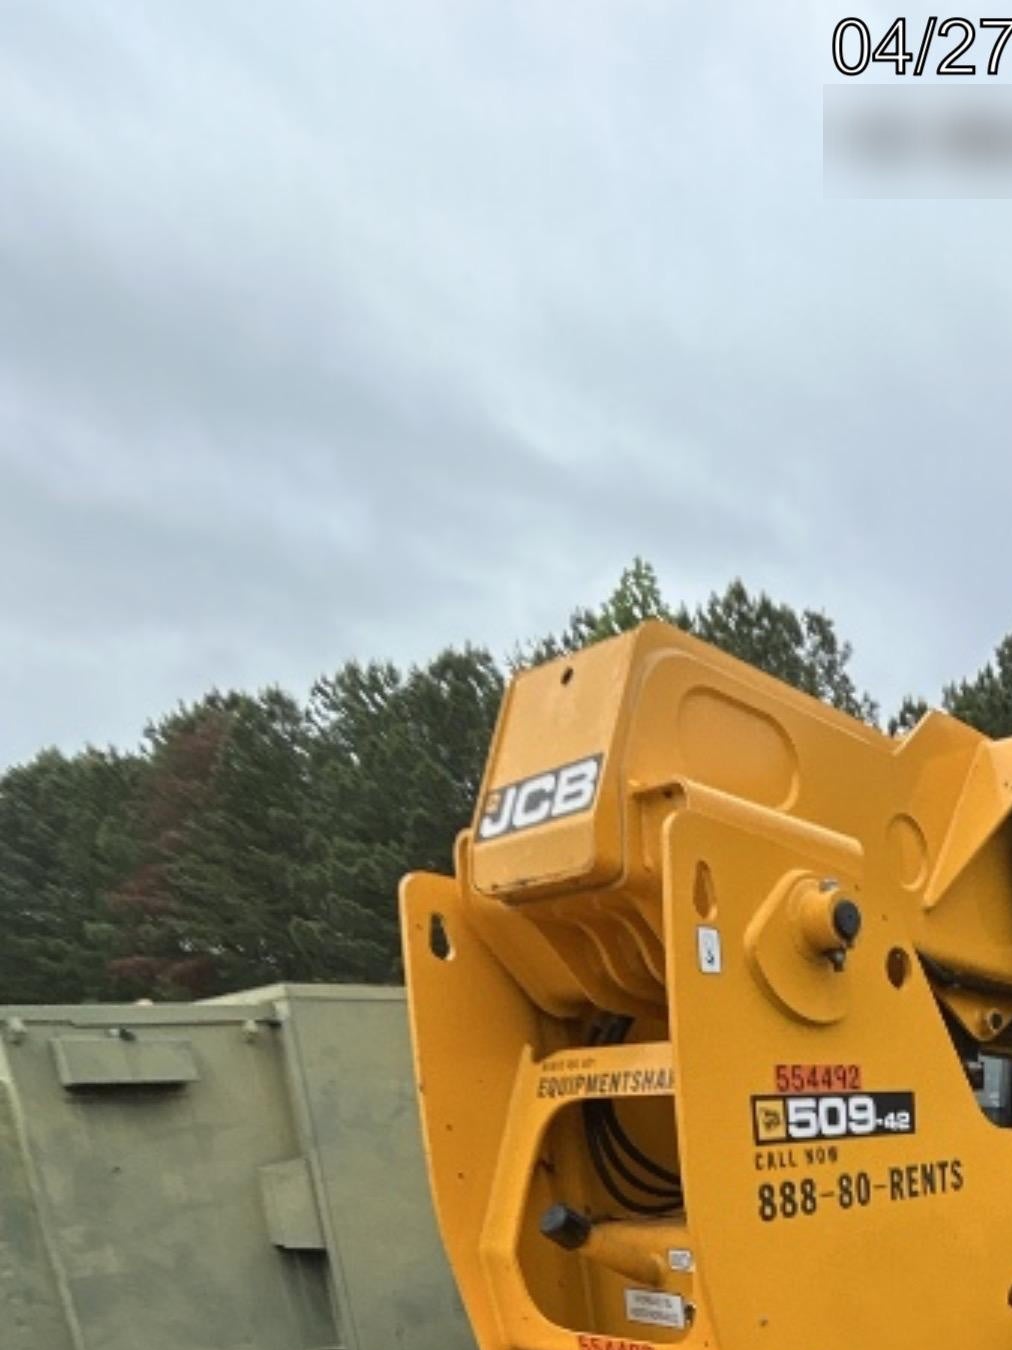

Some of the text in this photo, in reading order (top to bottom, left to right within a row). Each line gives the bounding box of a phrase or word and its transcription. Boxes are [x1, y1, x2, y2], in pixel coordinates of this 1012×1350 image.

[480, 758, 599, 838] JCB
[776, 1065, 860, 1092] 554492
[755, 1151, 798, 1170] CALL
[758, 1158, 964, 1222] 888-80-RENTS
